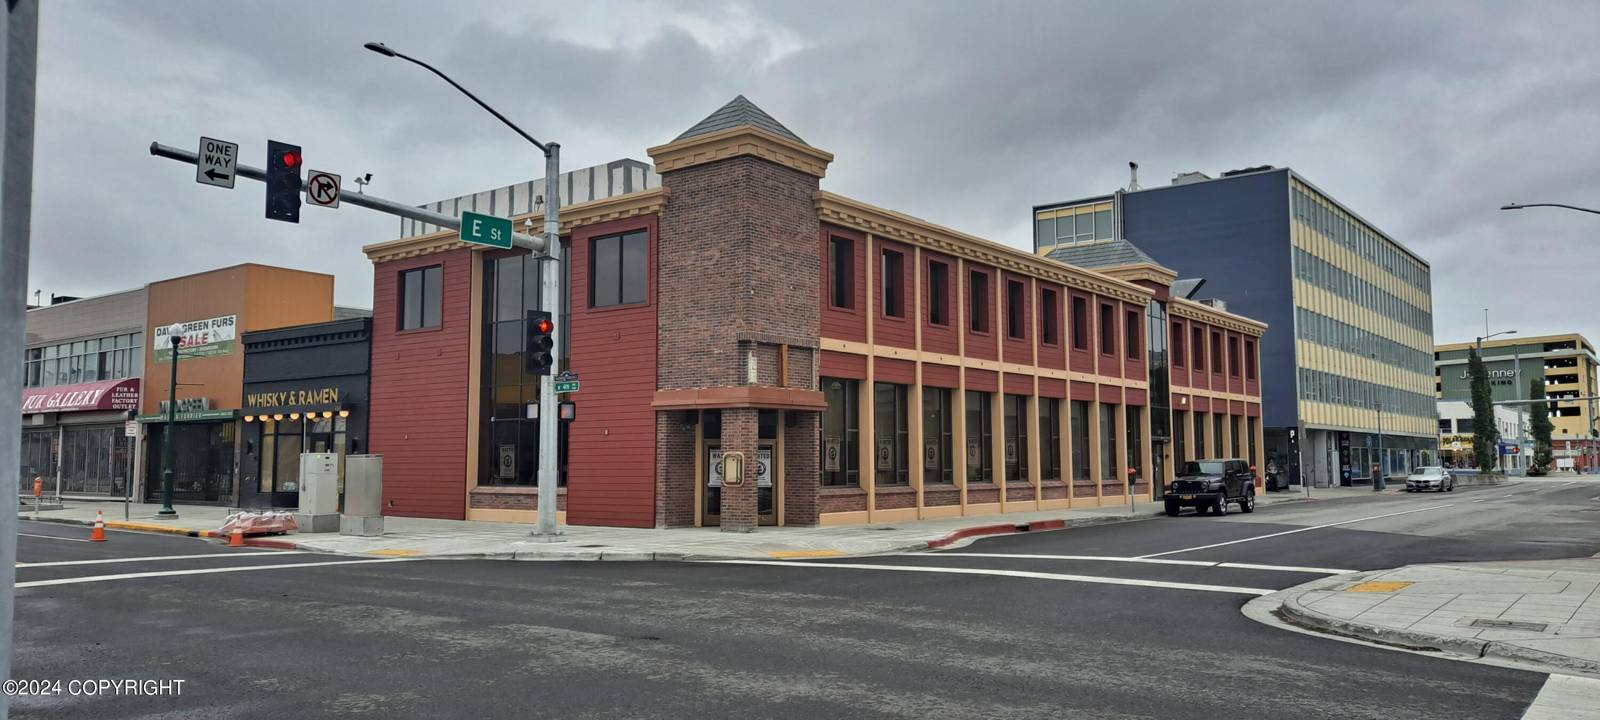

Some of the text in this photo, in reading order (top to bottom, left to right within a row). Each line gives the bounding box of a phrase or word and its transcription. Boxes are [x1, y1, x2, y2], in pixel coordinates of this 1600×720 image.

[206, 142, 231, 156] ONE
[205, 154, 231, 168] WAY
[472, 219, 501, 240] E St
[211, 316, 234, 329] FURS
[180, 332, 208, 347] SALE
[47, 389, 105, 407] GALLERY
[248, 388, 338, 408] WHISKY & RAMEN
